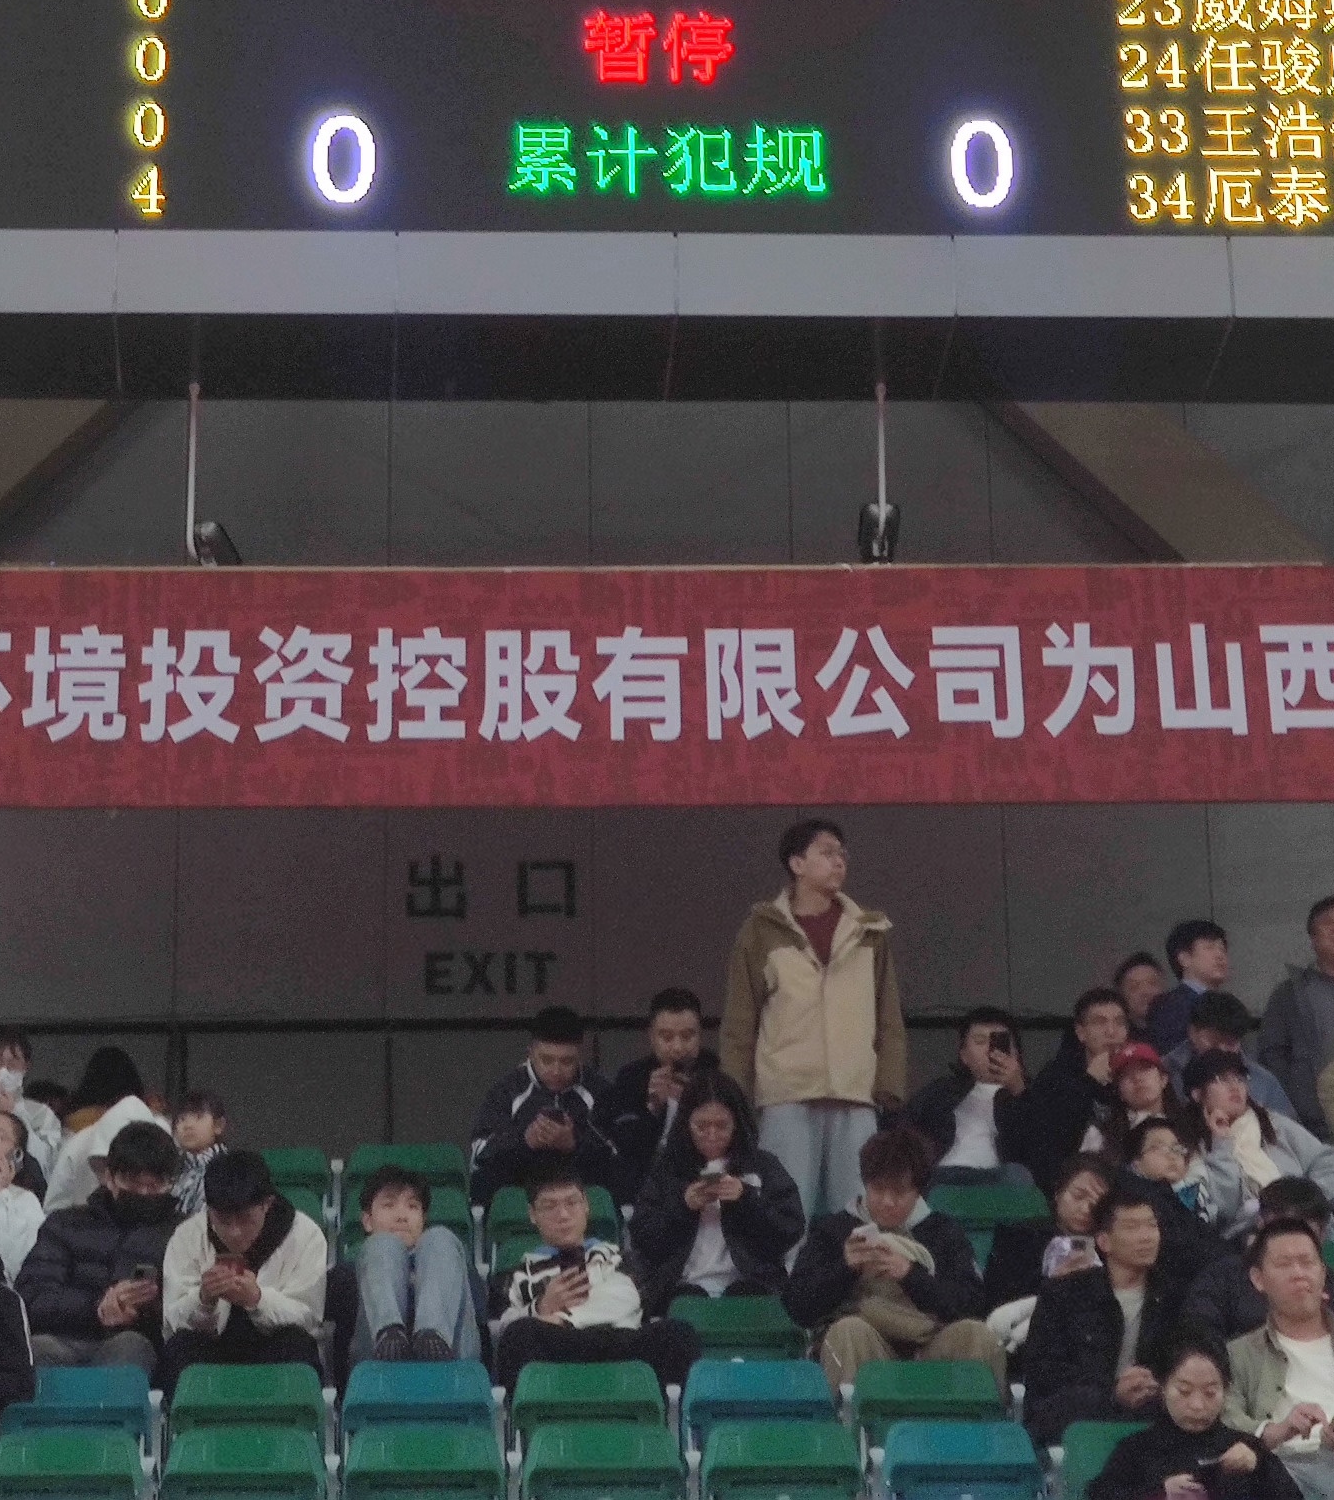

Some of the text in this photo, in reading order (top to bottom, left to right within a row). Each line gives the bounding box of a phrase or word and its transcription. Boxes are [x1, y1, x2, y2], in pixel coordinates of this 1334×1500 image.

[134, 36, 167, 83] 0
[583, 9, 733, 83] 暂停
[1118, 41, 1189, 90] 24
[131, 99, 166, 148] 0
[1124, 108, 1190, 155] 33
[311, 114, 377, 205] 0
[507, 122, 829, 197] 累计犯规
[949, 119, 1014, 209] 0
[129, 164, 167, 215] 4
[1127, 171, 1196, 221] 34
[425, 952, 557, 995] EXIT
